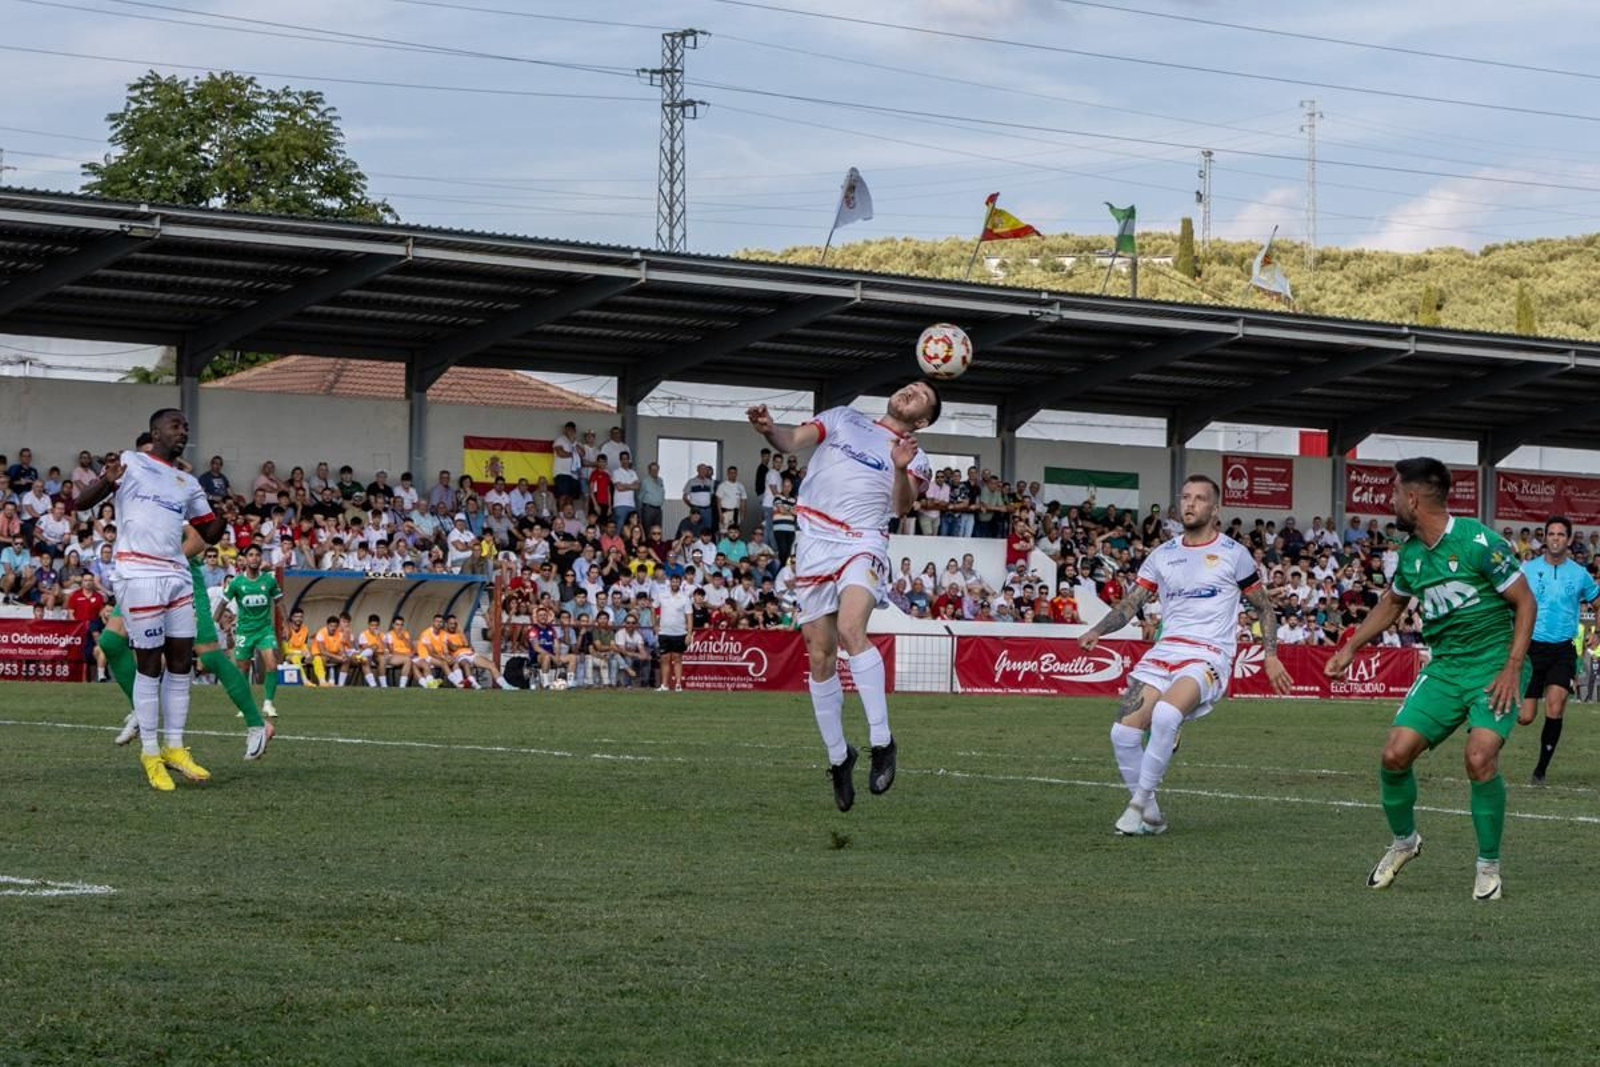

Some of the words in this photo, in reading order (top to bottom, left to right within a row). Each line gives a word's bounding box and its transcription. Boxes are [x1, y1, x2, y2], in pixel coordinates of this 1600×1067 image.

[1499, 476, 1518, 493] Los
[1521, 480, 1556, 495] Reales
[11, 632, 82, 647] Odontológica
[683, 631, 742, 654] haichio
[38, 664, 53, 676] 35
[55, 664, 70, 677] 88
[994, 650, 1038, 683] Grupo
[1040, 653, 1096, 674] Bonilla
[1330, 682, 1386, 693] ELECTRICIDAD
